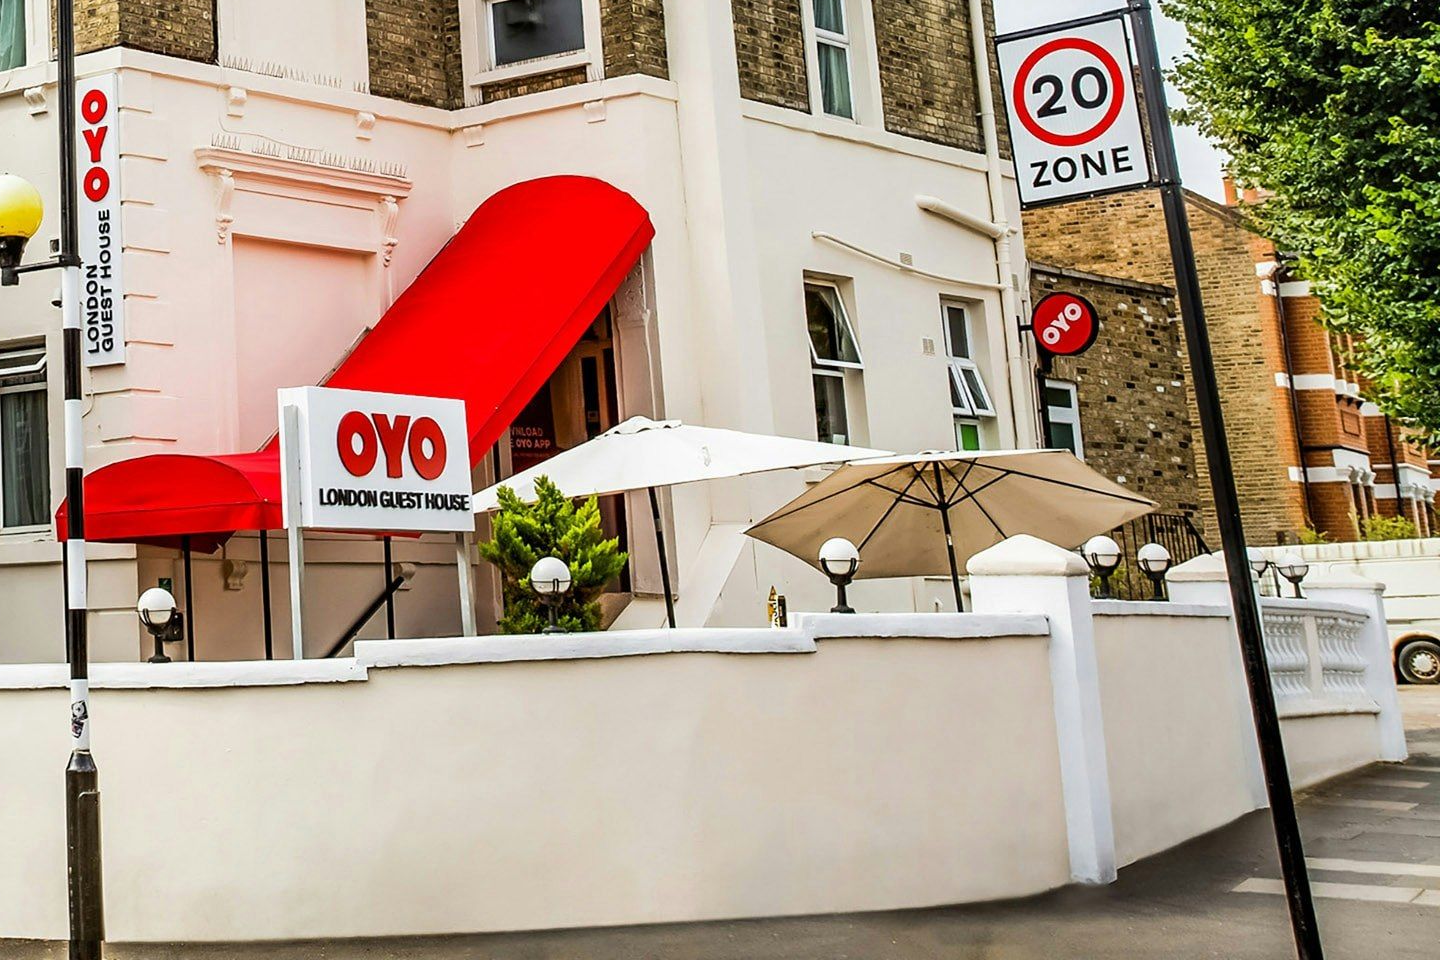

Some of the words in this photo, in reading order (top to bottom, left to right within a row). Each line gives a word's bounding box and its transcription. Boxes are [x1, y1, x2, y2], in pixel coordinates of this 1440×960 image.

[1032, 66, 1108, 119] 20
[81, 89, 110, 202] OYO
[1030, 146, 1133, 188] ZONE
[98, 209, 111, 279] HOUSE
[86, 264, 100, 354] LONDON
[99, 286, 114, 353] GUEST
[1042, 302, 1082, 345] OYO
[337, 411, 447, 480] OYO
[516, 438, 532, 448] OYO
[534, 439, 550, 448] APP
[319, 488, 377, 507] LONDON
[379, 491, 423, 509] GUEST
[425, 493, 470, 511] HOUSE
